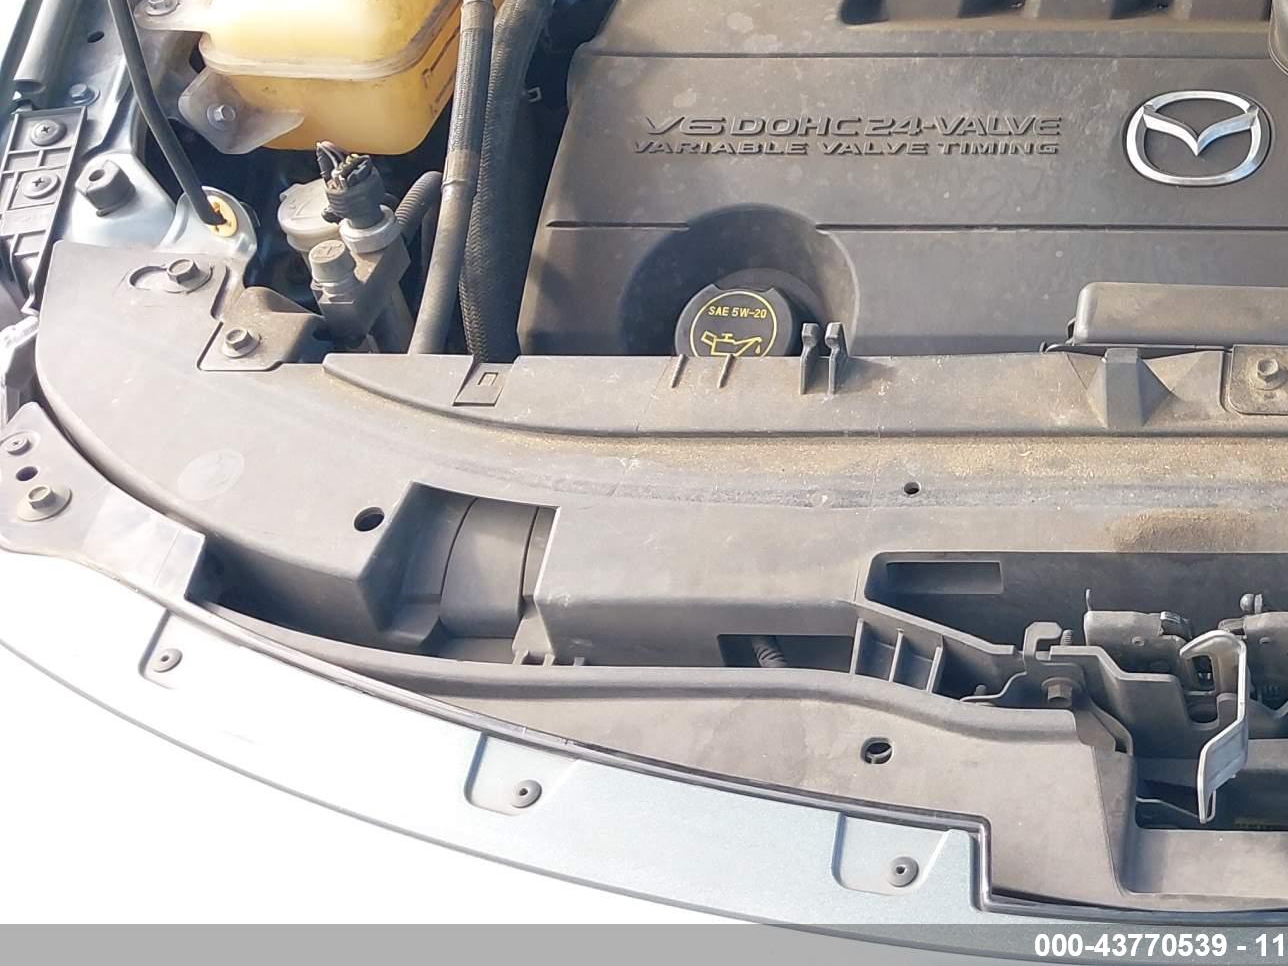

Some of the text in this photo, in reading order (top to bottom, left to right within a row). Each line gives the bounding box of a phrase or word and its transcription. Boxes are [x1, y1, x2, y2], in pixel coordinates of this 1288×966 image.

[646, 114, 1063, 136] V6 DOHC 24-VALVE
[634, 140, 1060, 155] VARIABLE VALVE TIMING
[708, 305, 768, 319] SAE 5W-20
